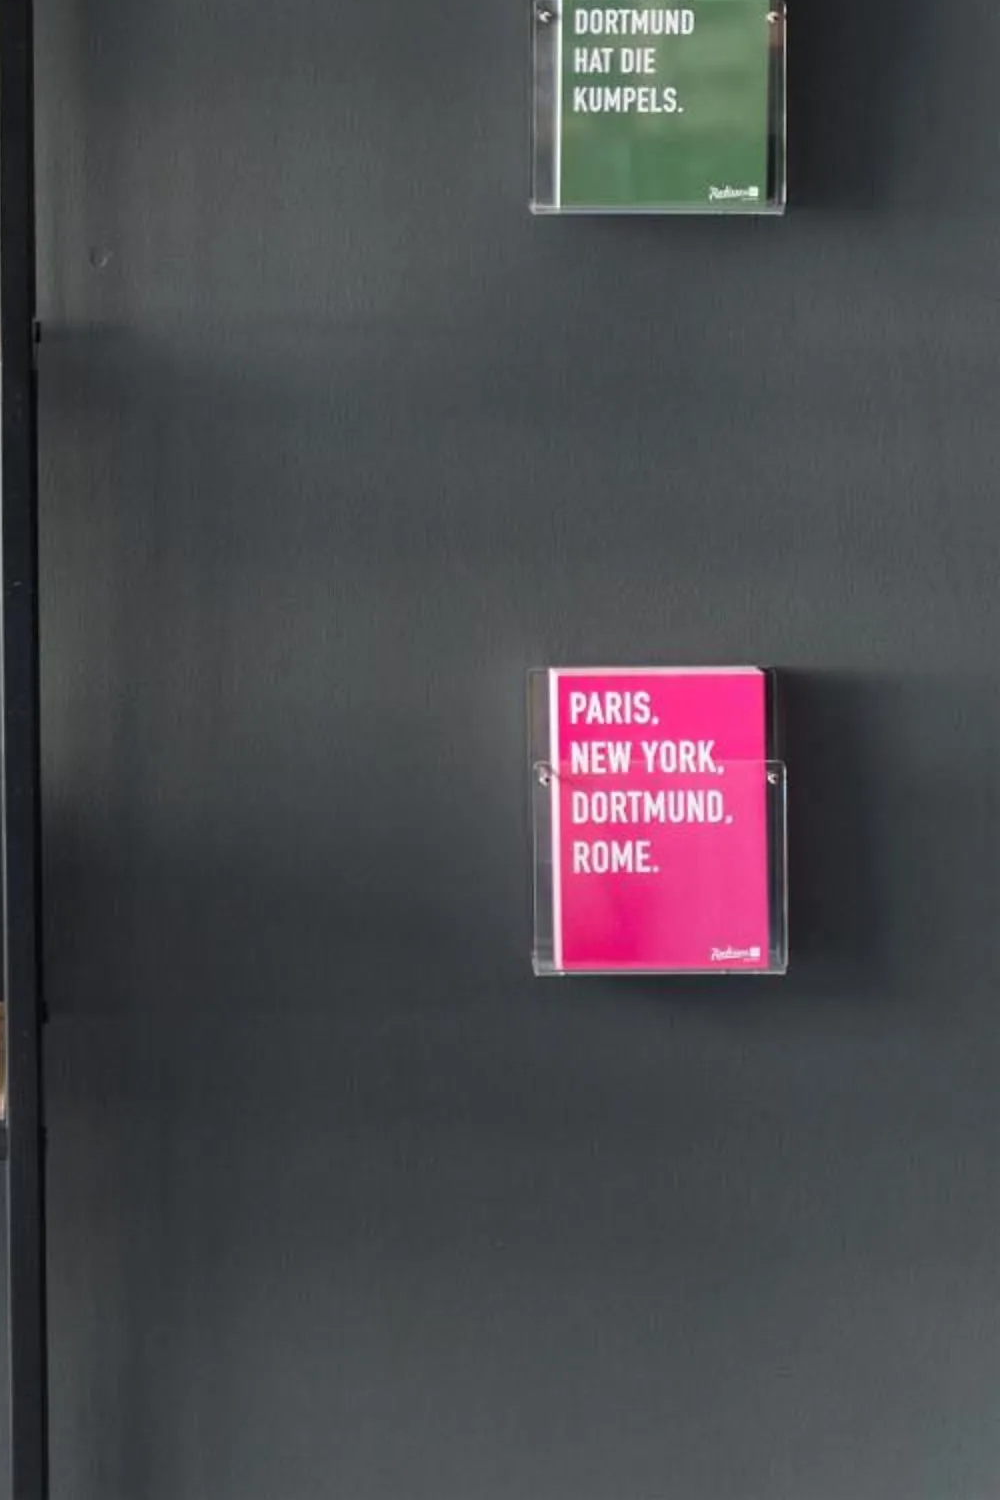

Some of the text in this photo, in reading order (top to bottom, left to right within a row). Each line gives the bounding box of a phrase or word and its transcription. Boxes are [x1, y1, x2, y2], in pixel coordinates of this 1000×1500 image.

[574, 9, 695, 35] DORTMUND
[574, 48, 656, 74] HAT DIE
[573, 87, 683, 113] KUMPELS.
[570, 741, 632, 774] NEW
[573, 840, 660, 873] ROME.
